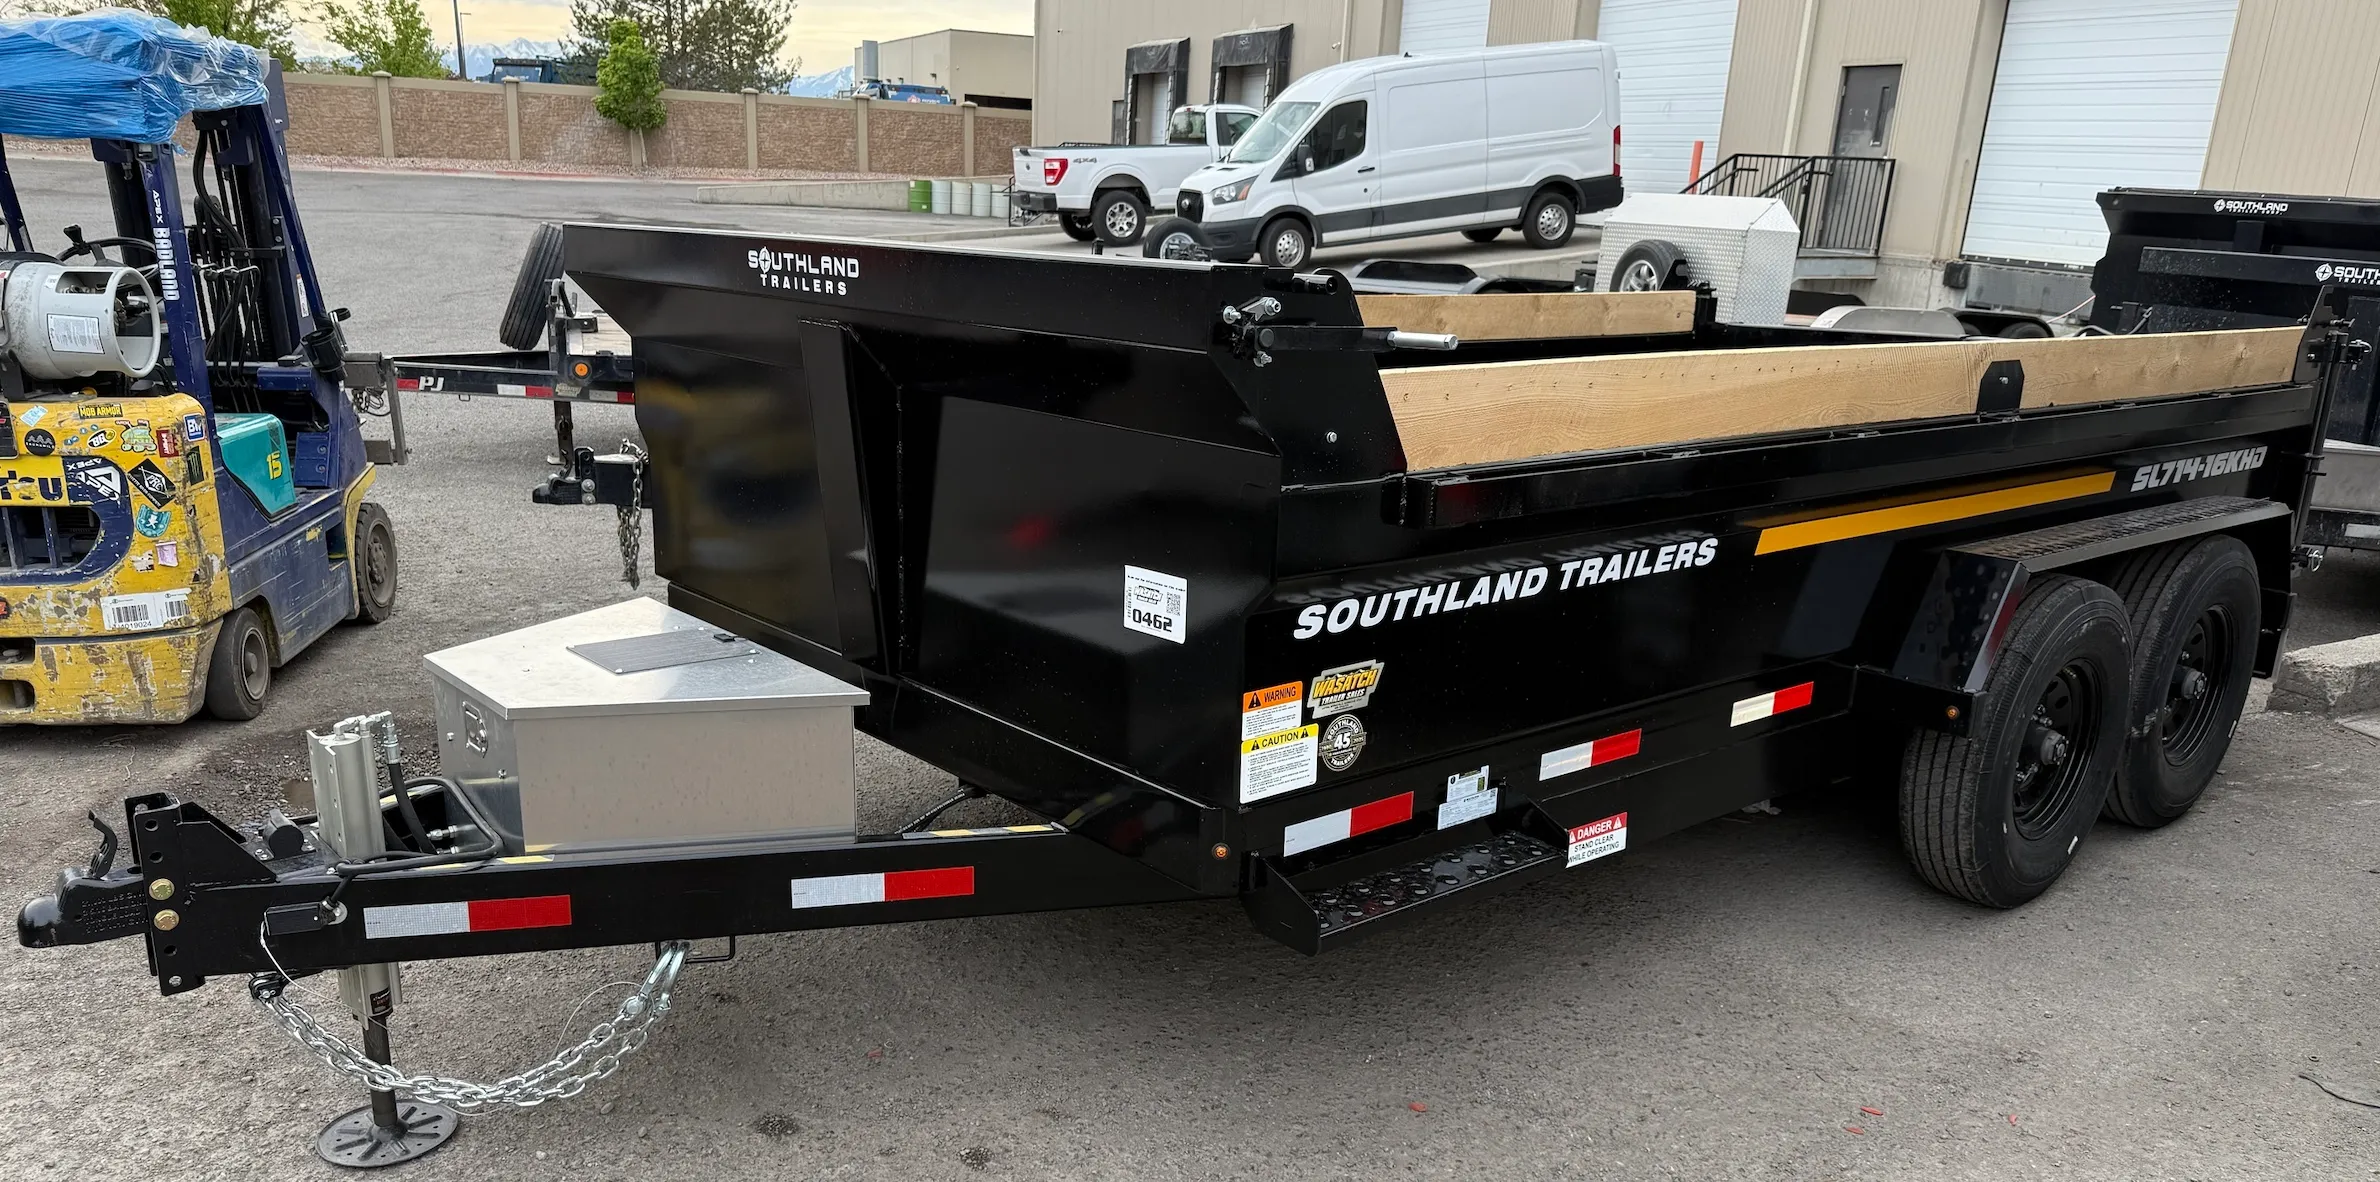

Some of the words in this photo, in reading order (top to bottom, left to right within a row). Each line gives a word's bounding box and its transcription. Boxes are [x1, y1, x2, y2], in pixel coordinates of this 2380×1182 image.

[152, 189, 164, 224] APEX
[2226, 200, 2288, 212] SOUTHLAND
[153, 227, 180, 300] BADLAND
[748, 246, 859, 278] SOUTHLAND
[760, 274, 847, 296] TRAILERS
[418, 376, 444, 392] PJ
[79, 407, 96, 417] MOB
[97, 406, 121, 416] ARMOR
[67, 458, 102, 471] APEX
[2130, 446, 2268, 492] SL714-16KHD
[1293, 566, 1549, 640] SOUTHLAND
[1559, 538, 1719, 590] TRAILERS
[1132, 608, 1173, 633] 0462
[1313, 669, 1379, 699] WASATCH
[1264, 686, 1297, 703] WARNING
[1321, 692, 1346, 706] TRAILER
[1346, 688, 1366, 700] SALES
[1262, 731, 1299, 748] CAUTION
[1334, 731, 1352, 750] 45
[1577, 819, 1612, 840] DANGER
[1574, 840, 1593, 853] STAND
[1594, 834, 1614, 846] CLEAR
[1586, 841, 1620, 858] OPERATING
